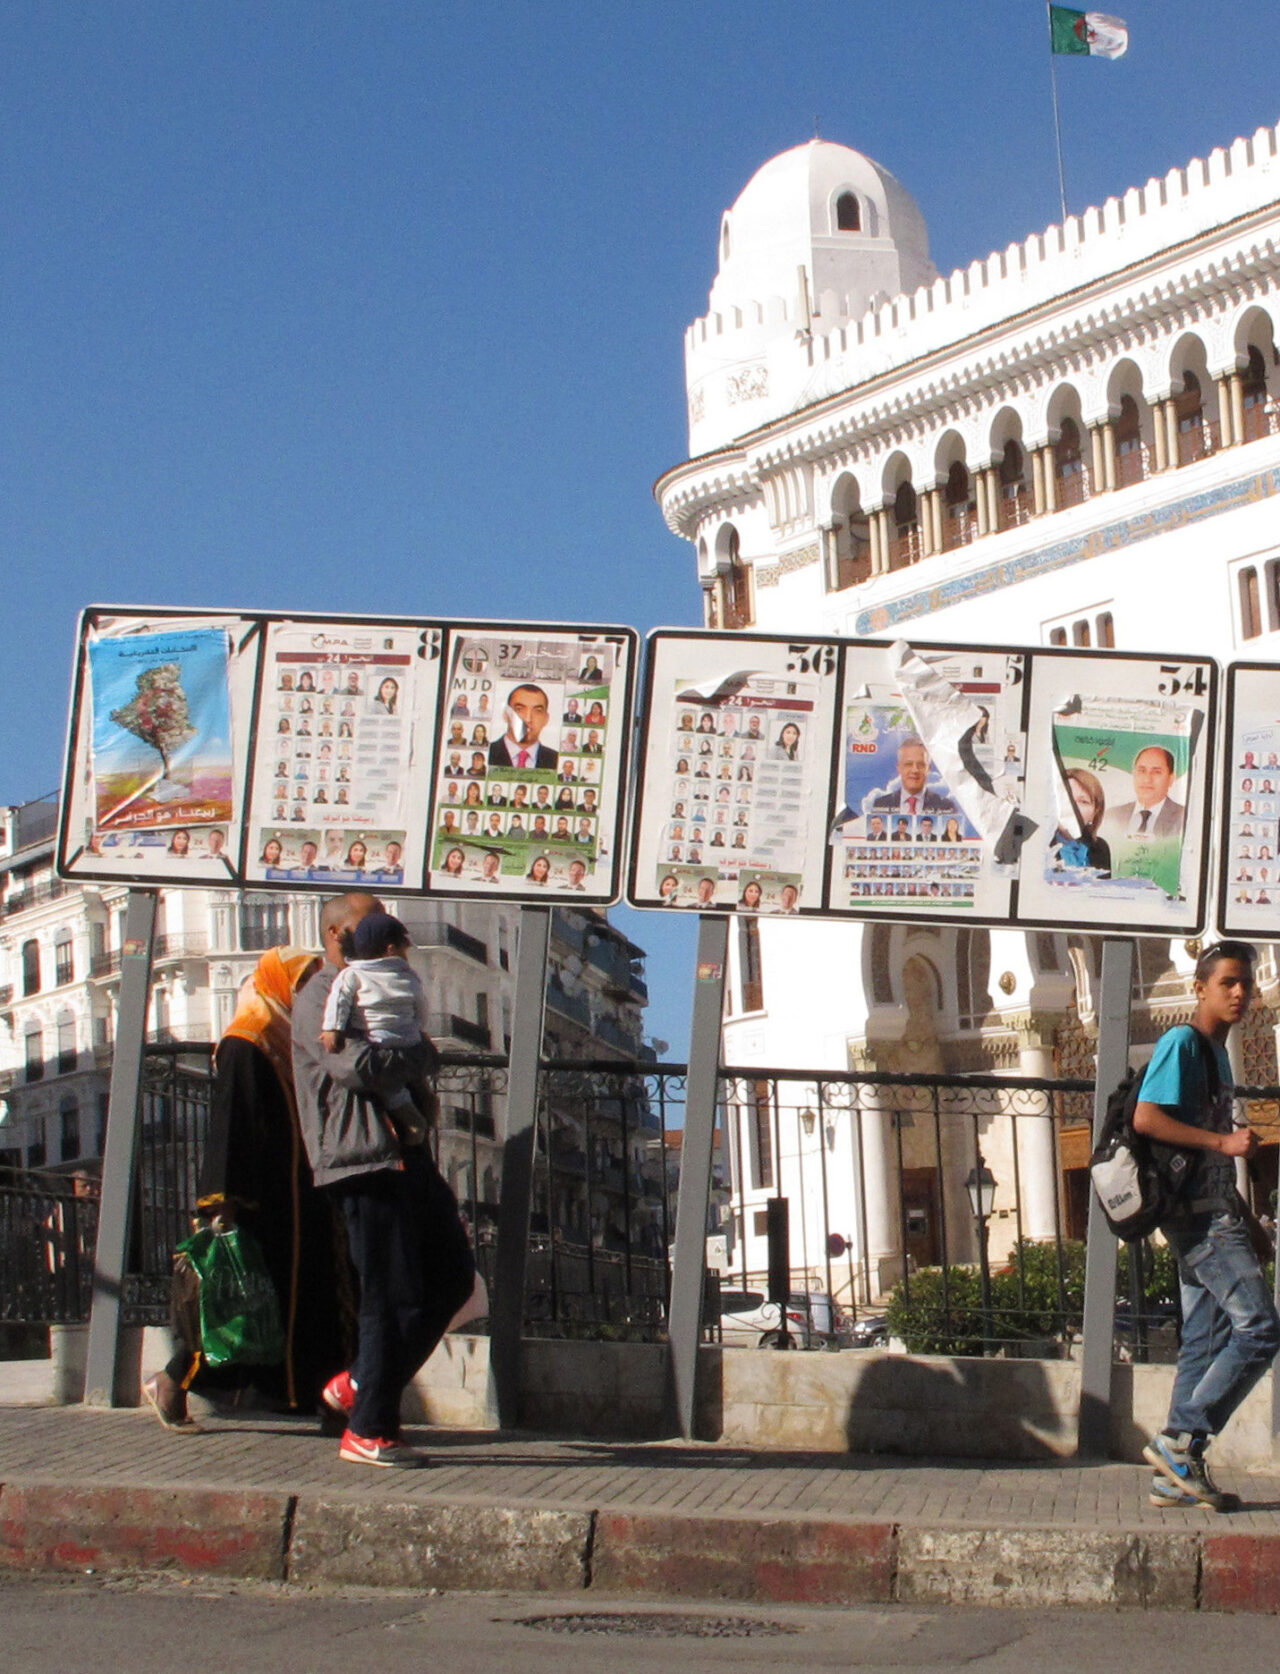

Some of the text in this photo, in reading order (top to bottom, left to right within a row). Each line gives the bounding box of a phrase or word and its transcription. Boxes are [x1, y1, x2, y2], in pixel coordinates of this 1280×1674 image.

[417, 630, 441, 661] 8
[498, 644, 523, 660] 37
[326, 653, 341, 664] 24
[786, 644, 836, 677] 36
[1005, 655, 1023, 686] 5
[1158, 665, 1208, 697] 34
[728, 696, 743, 706] 24
[852, 743, 877, 753] RND
[1087, 757, 1109, 772] 42
